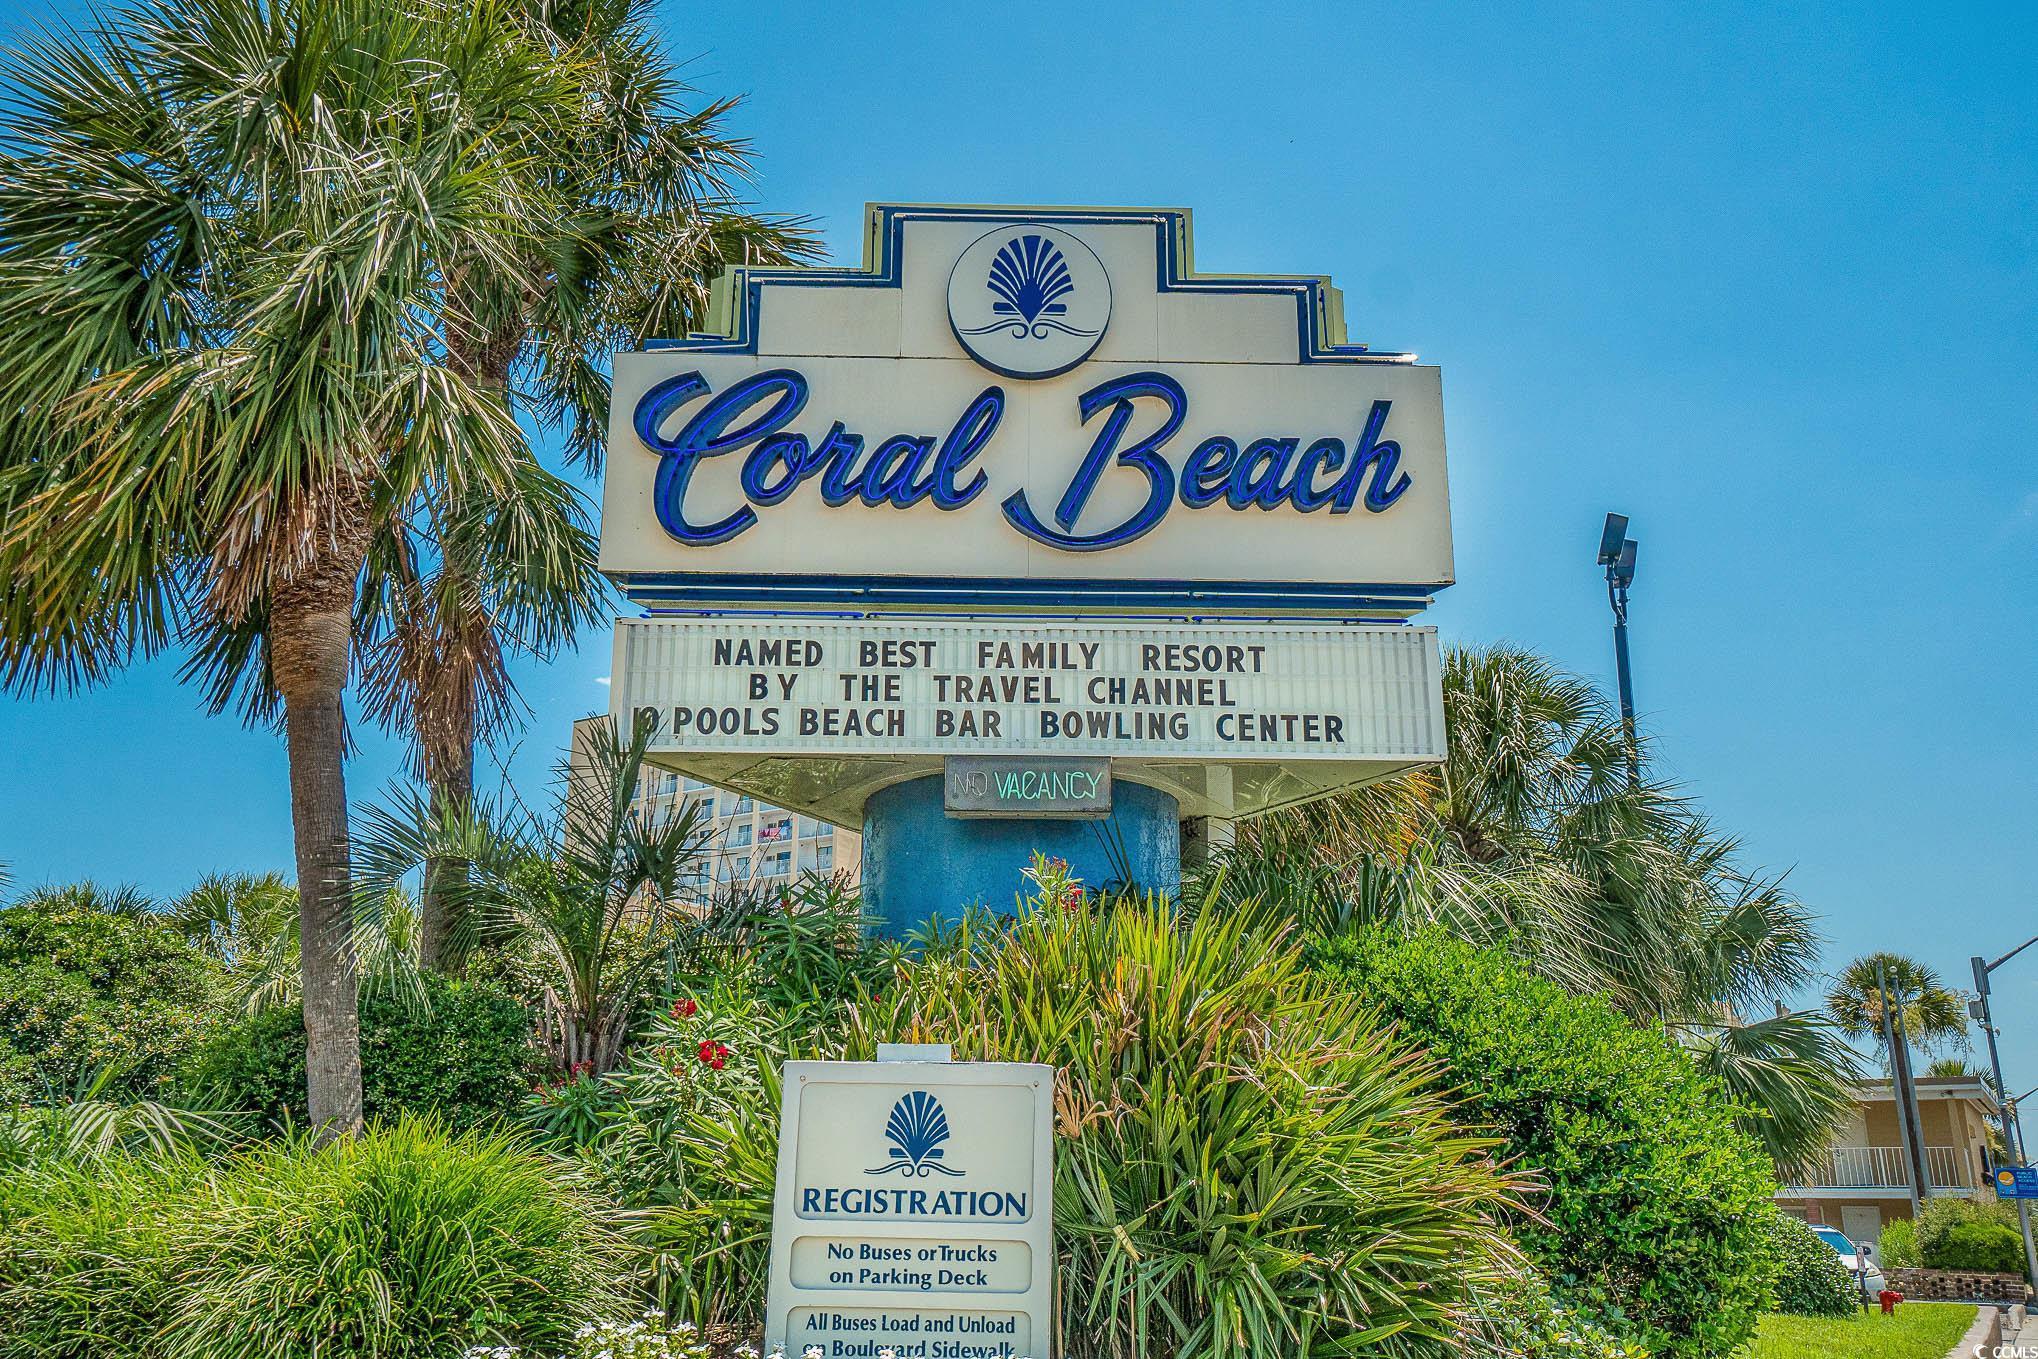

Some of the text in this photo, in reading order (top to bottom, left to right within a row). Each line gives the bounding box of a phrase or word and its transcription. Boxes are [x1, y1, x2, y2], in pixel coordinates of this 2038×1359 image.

[633, 368, 1413, 552] Coral Beach
[714, 638, 1266, 673] NAMED BEST FAMILY RESORT
[749, 673, 1236, 706] BY THE TRAVEL CHANNEL
[673, 706, 780, 736] POOLS
[800, 708, 906, 737] BEACH
[935, 709, 1003, 738] BAR
[1040, 710, 1189, 740] BOWLING
[1216, 713, 1345, 743] CENTER
[954, 770, 1103, 800] NO VACANCY
[802, 1188, 1027, 1217] REGISTRATION
[827, 1243, 997, 1262] No Buses or Trucks
[829, 1268, 988, 1290] on Parking Deck
[806, 1313, 1015, 1334] All Buses Load and Unload
